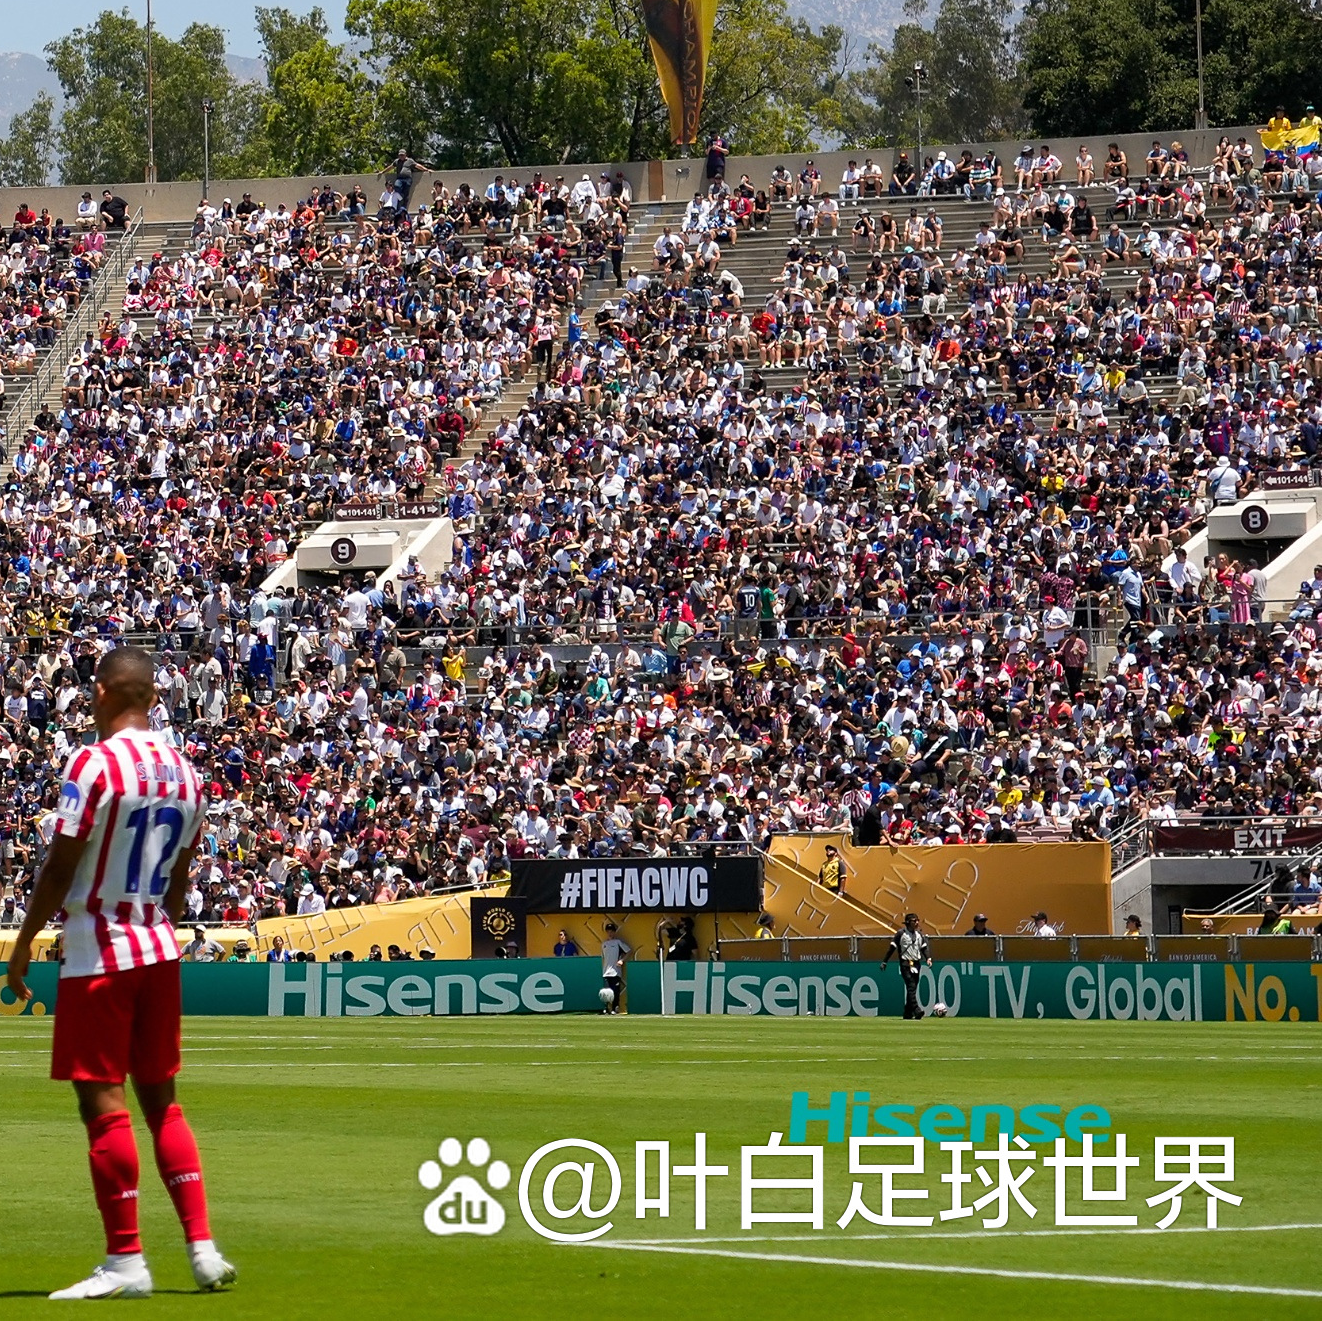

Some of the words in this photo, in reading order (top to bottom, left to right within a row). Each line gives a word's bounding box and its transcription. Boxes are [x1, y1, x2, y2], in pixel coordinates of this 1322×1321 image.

[1276, 474, 1309, 485] 101-141
[347, 508, 376, 517] 101-141
[400, 505, 426, 516] 1-41
[1247, 511, 1262, 528] 8
[336, 543, 350, 559] 9
[744, 593, 756, 608] 10
[136, 761, 151, 781] S.
[153, 763, 186, 785] LINO
[1234, 828, 1287, 849] EXIT
[125, 806, 184, 896] 12
[1250, 860, 1274, 880] 7A
[559, 865, 709, 909] #FIFACWC
[819, 954, 841, 962] AMERICA
[1192, 953, 1217, 961] AMERICA
[267, 962, 564, 1017] Hisense
[663, 961, 879, 1017] Hisense
[980, 963, 1045, 1020] TV,
[1064, 963, 1203, 1022] Global
[1224, 963, 1300, 1023] No.
